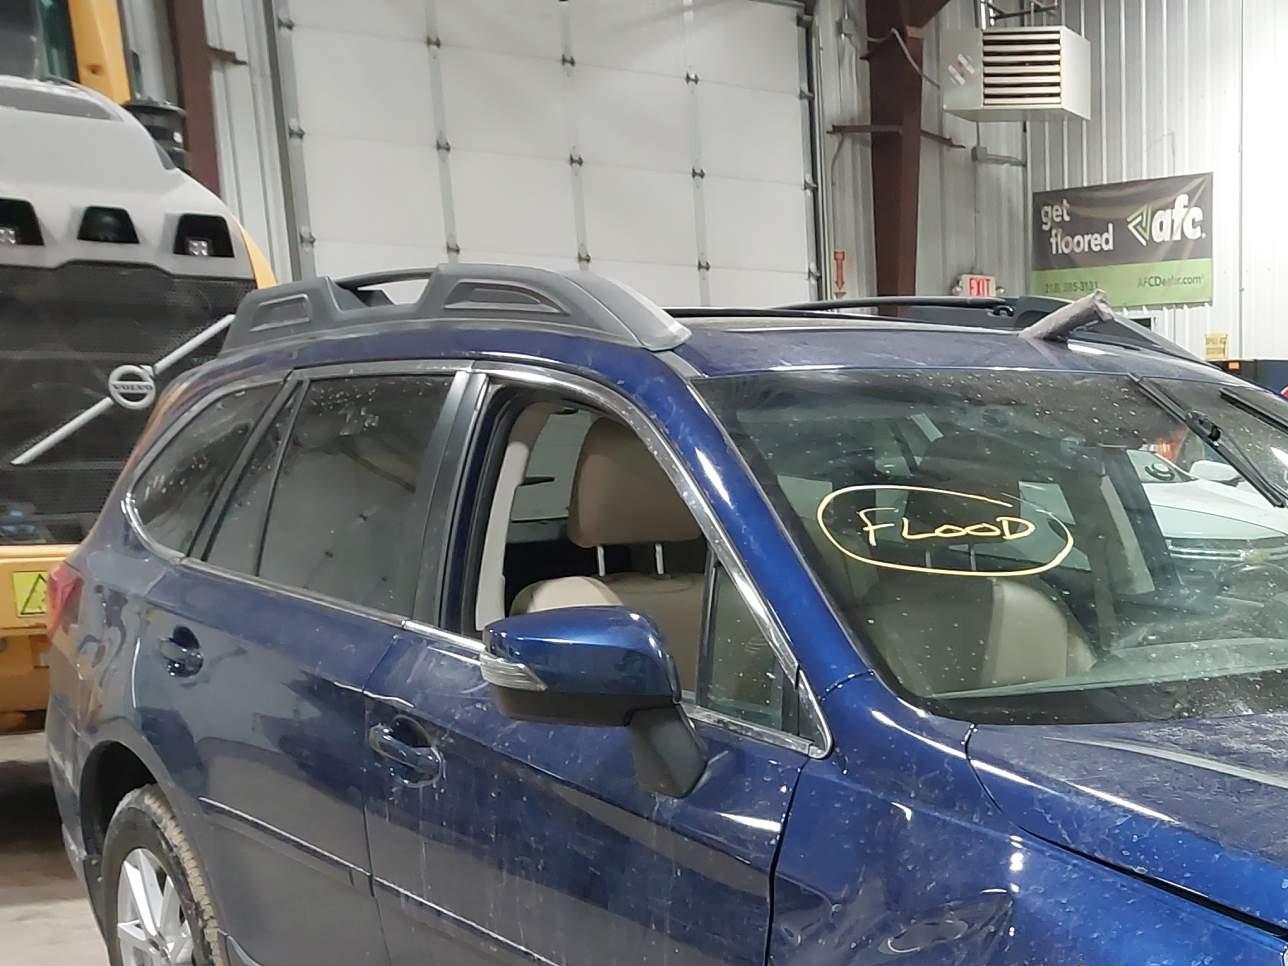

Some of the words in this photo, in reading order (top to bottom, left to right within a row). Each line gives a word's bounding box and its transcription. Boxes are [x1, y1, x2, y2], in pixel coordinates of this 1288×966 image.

[1041, 199, 1071, 231] get
[1050, 223, 1114, 255] floored
[969, 277, 991, 297] EXIT
[111, 383, 153, 391] VOLVO
[857, 507, 1036, 547] FLOOD
